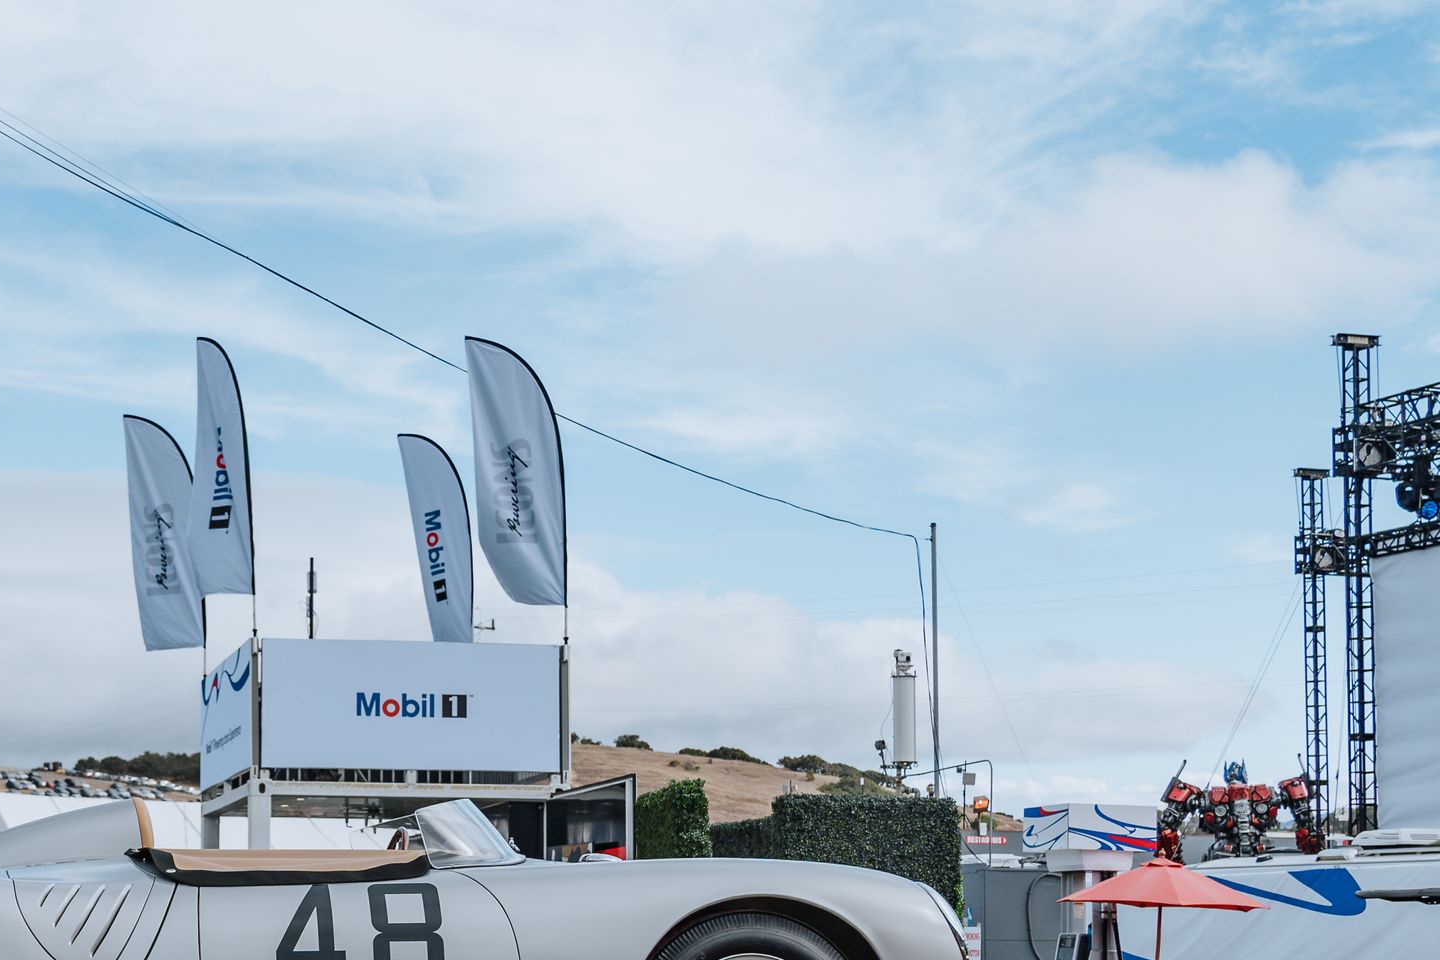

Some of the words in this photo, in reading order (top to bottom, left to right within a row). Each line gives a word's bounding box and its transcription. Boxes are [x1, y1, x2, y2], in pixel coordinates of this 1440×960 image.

[490, 438, 538, 544] ICONS
[505, 445, 528, 537] Powering
[154, 510, 172, 590] Powering
[424, 509, 446, 577] Mobil
[356, 692, 435, 718] Mobil
